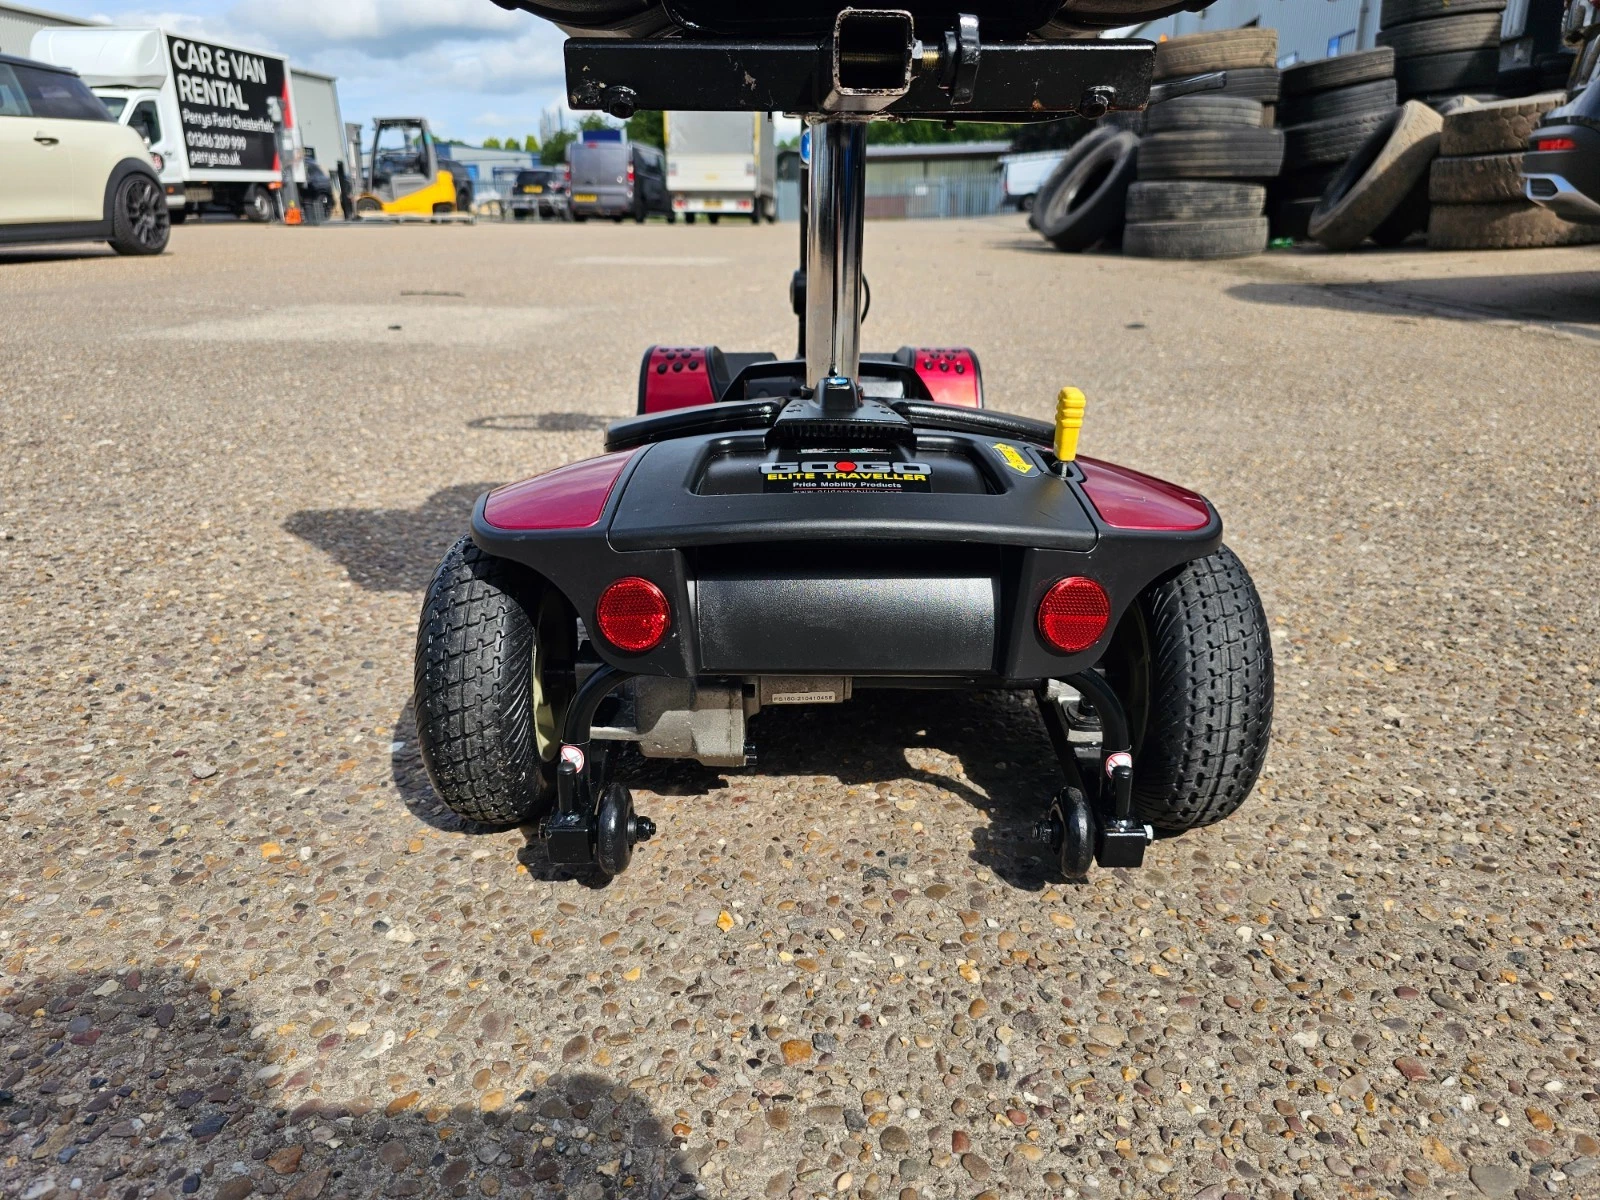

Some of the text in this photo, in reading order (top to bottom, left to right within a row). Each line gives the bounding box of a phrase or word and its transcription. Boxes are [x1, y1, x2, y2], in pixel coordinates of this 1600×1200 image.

[172, 40, 267, 84] CAR & VAN
[177, 73, 249, 111] RENTAL
[182, 109, 212, 129] Perrys
[212, 113, 231, 129] Ford
[190, 151, 241, 167] perrys.co.uk
[767, 473, 927, 481] ELITE TRAVELLER
